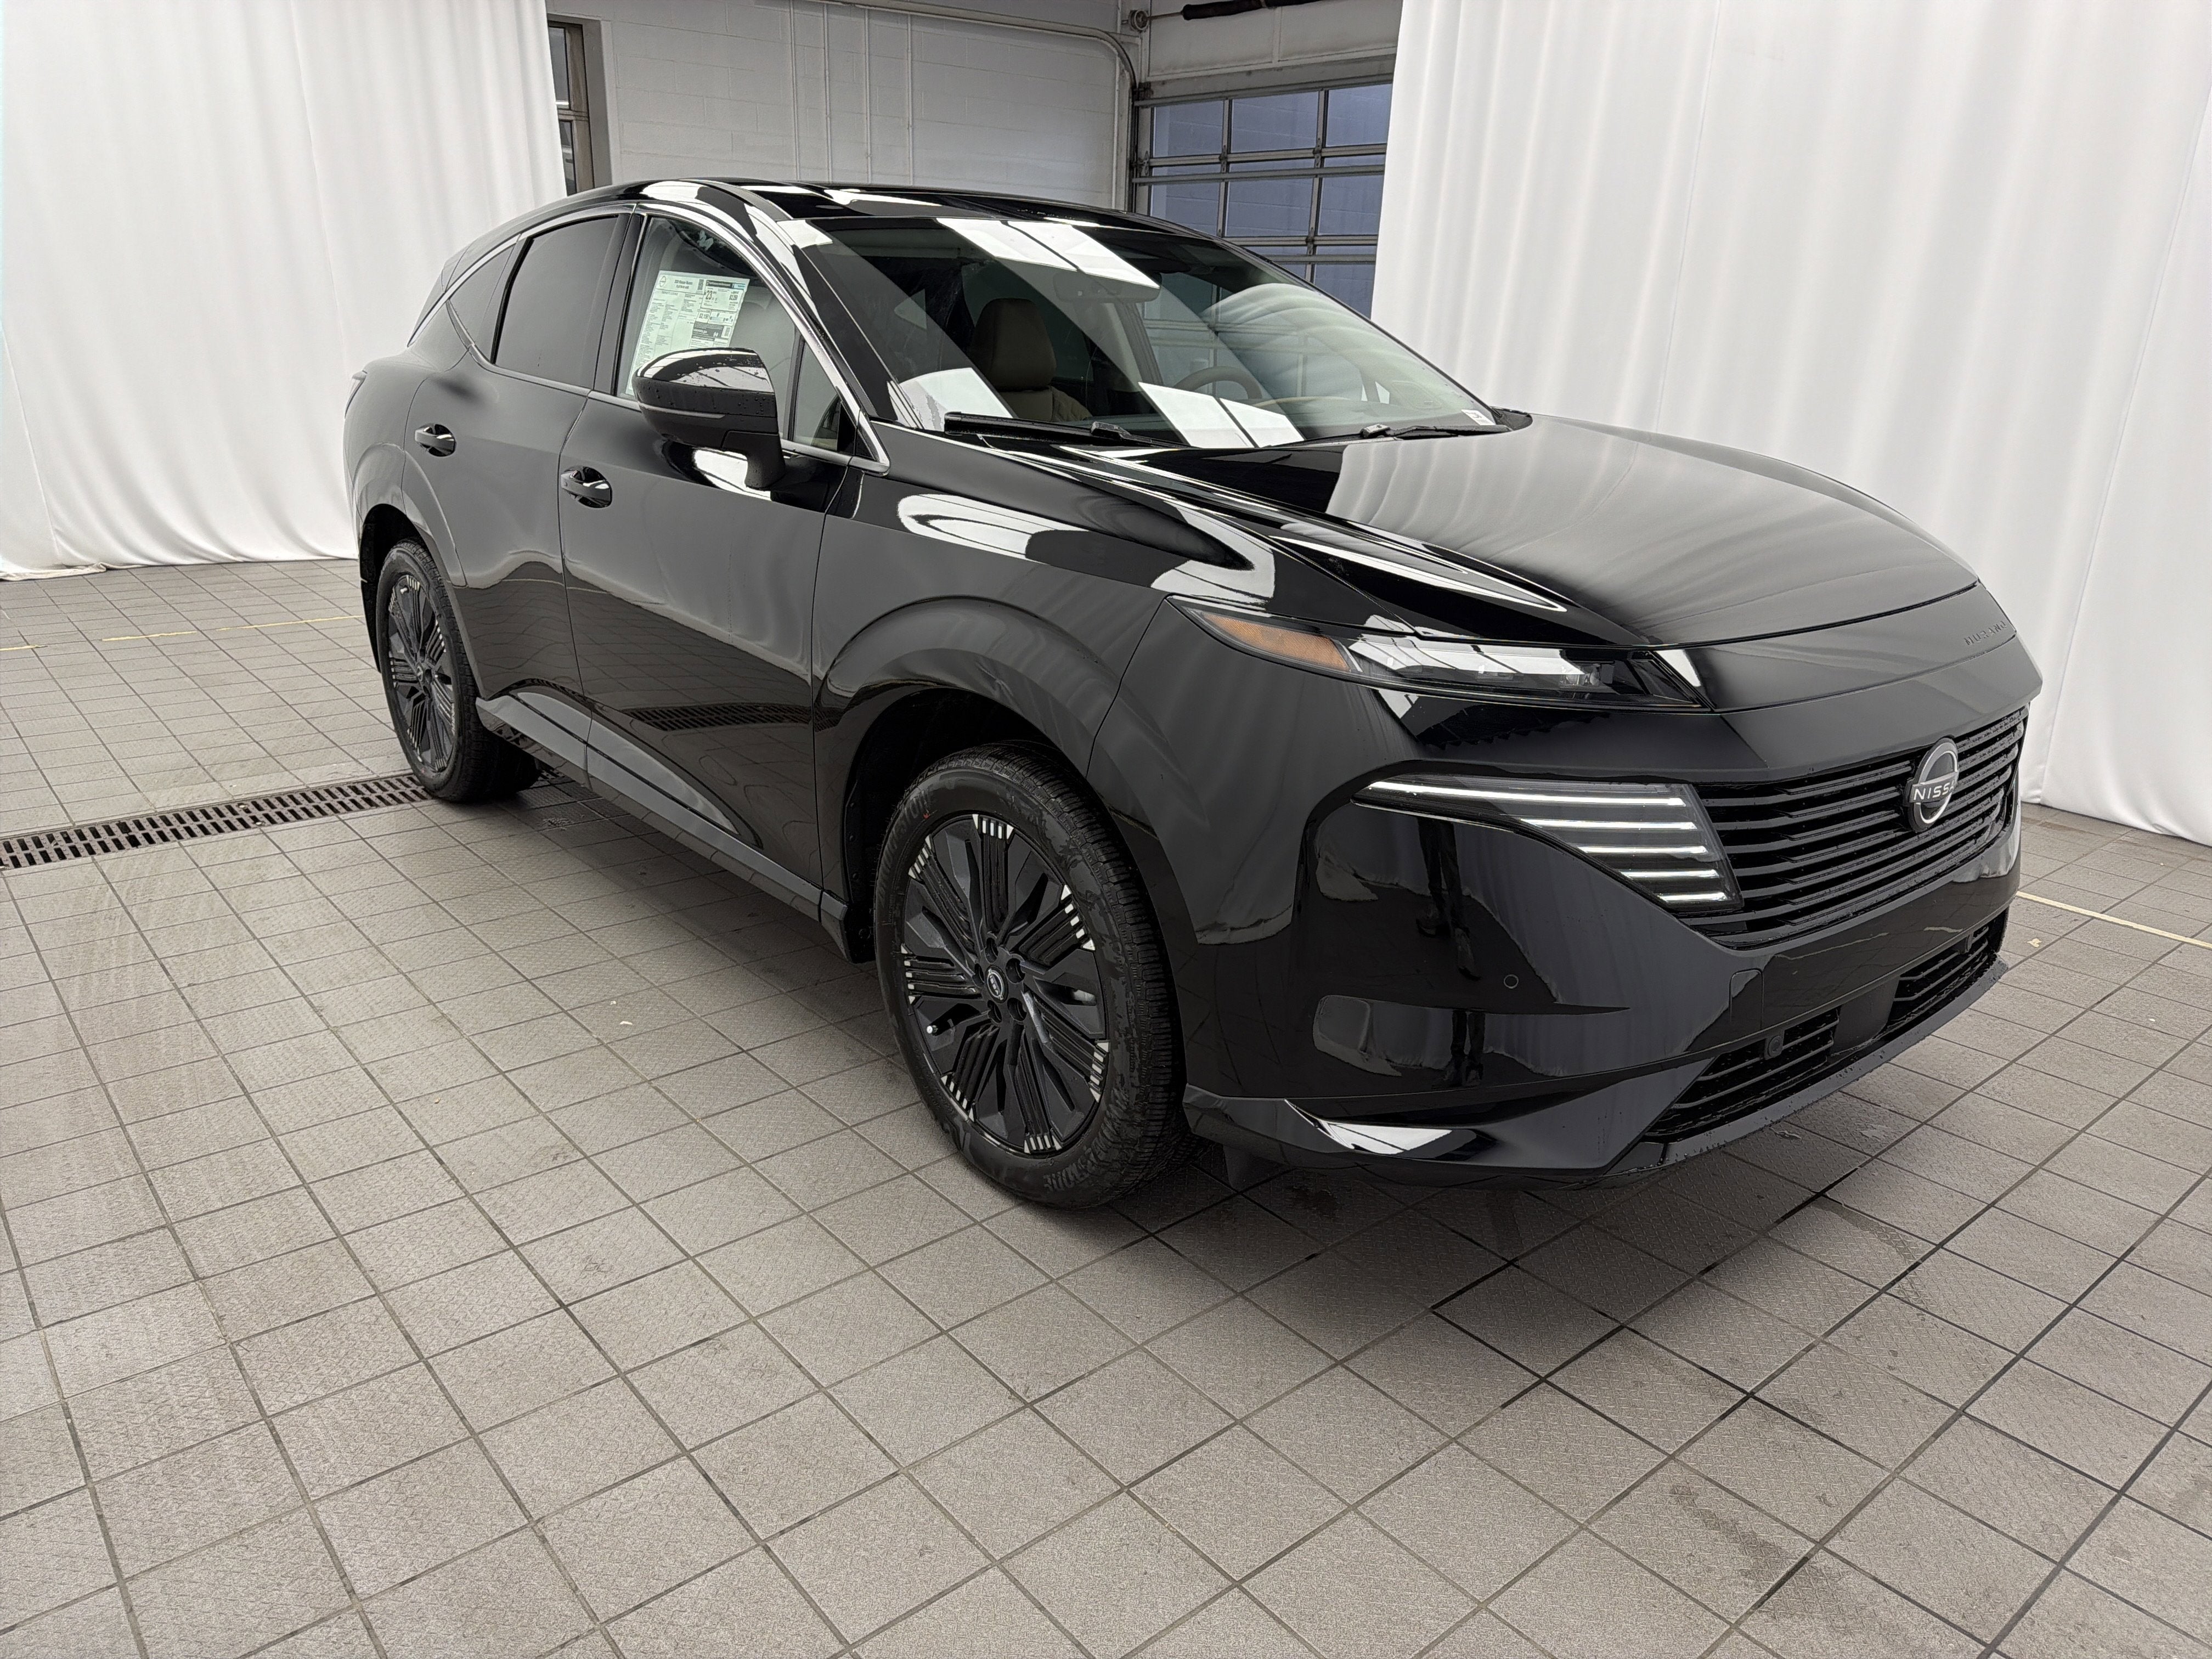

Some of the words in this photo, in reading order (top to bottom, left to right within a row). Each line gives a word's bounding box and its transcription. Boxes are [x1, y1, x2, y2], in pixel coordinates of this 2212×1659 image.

[706, 290, 712, 300] 23
[1964, 620, 2007, 645] MURANO
[1913, 778, 1955, 800] NISSA
